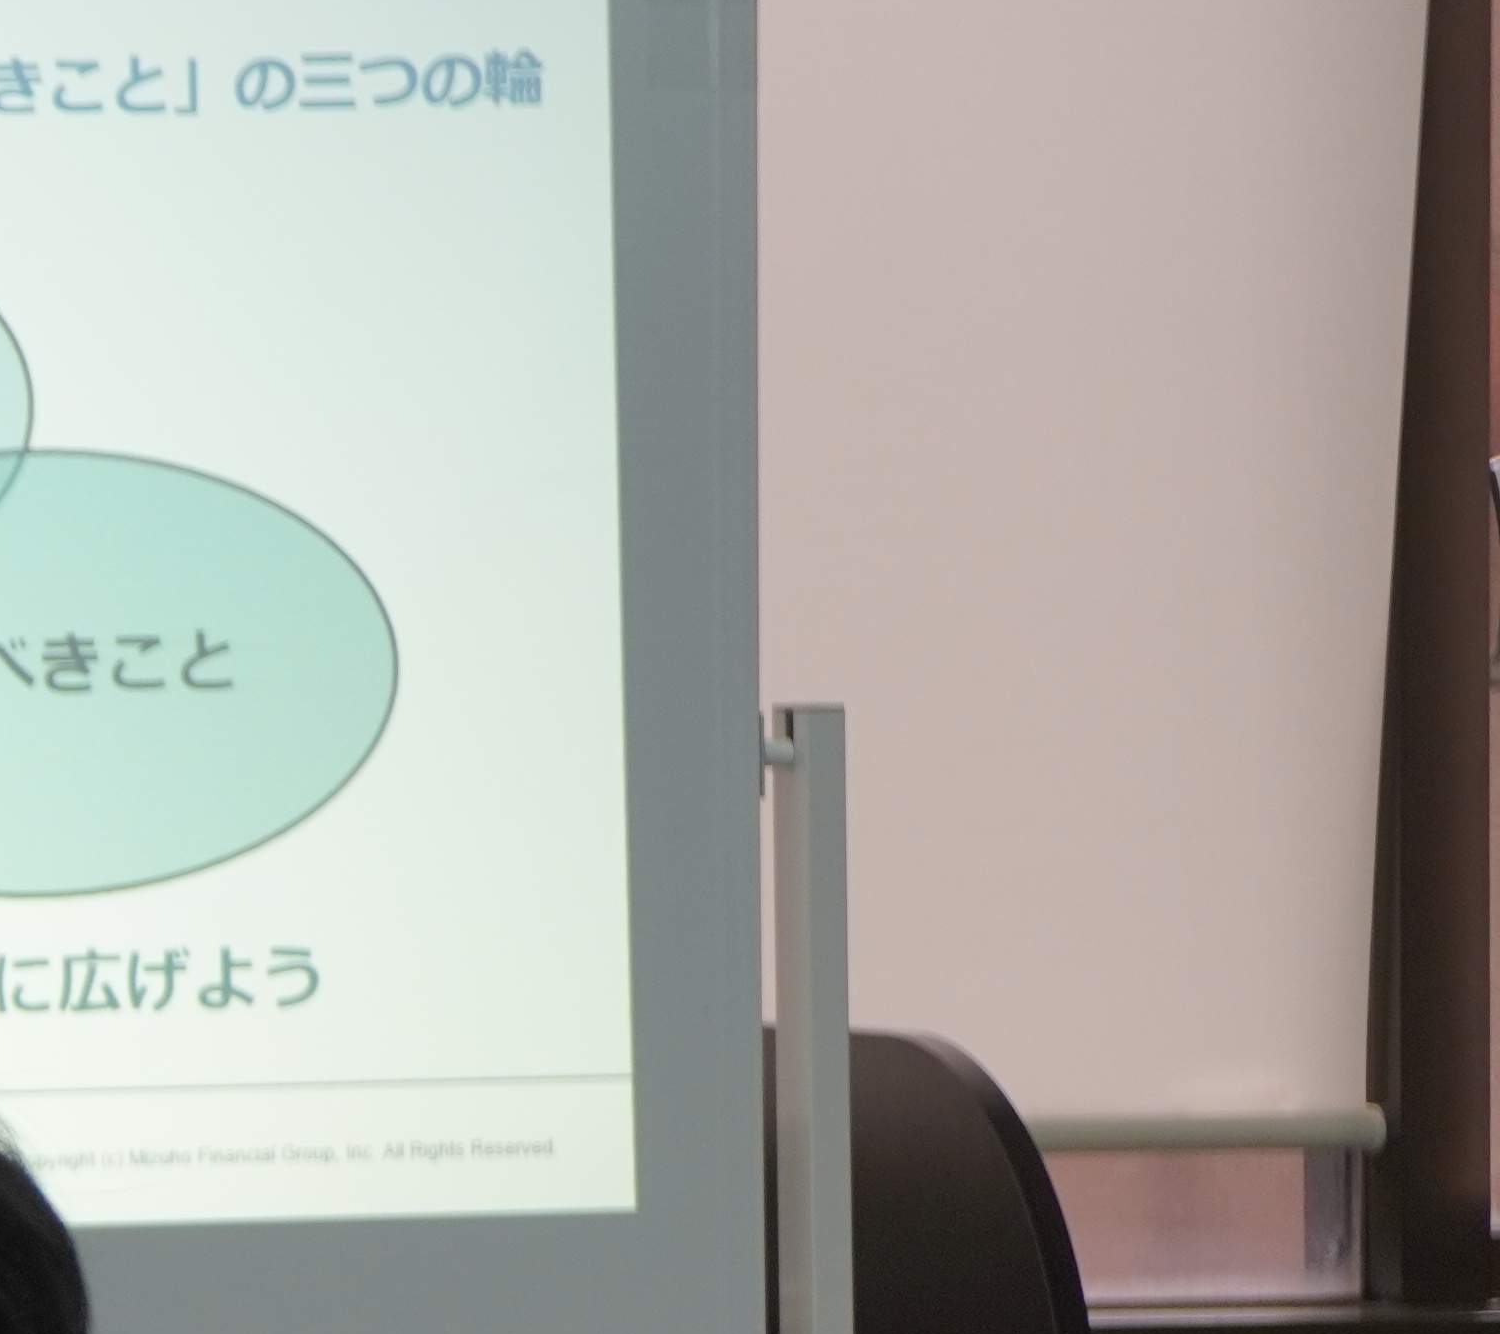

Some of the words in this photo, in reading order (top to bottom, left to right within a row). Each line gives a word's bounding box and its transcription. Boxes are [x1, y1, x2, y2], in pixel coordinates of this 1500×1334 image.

[129, 1147, 192, 1165] Mizuho
[198, 1143, 276, 1163] Financial
[383, 1141, 405, 1158] All
[410, 1139, 465, 1160] Rights
